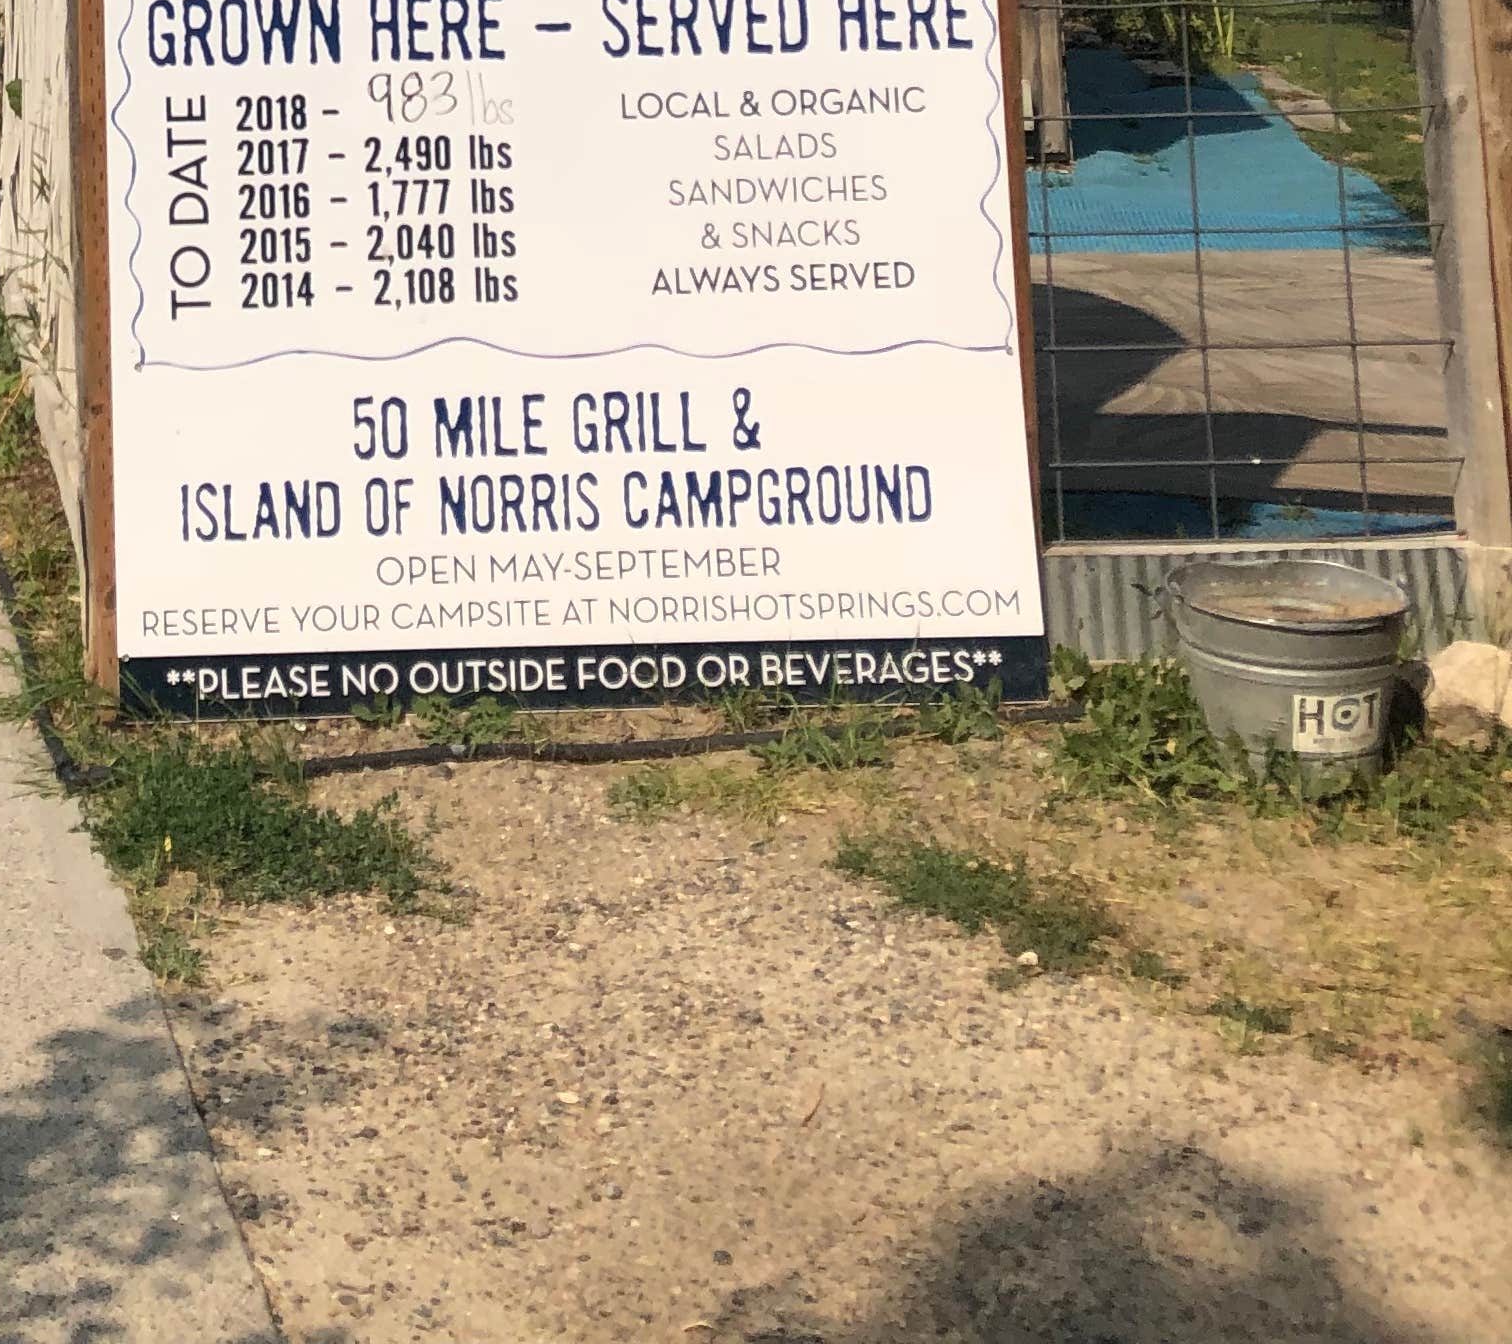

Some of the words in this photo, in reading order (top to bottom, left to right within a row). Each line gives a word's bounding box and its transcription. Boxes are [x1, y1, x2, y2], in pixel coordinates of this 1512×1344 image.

[235, 94, 307, 132] 2018
[367, 71, 458, 123] 983
[621, 91, 730, 120] LOCAL
[739, 90, 762, 117] &
[771, 86, 926, 116] ORGANIC
[165, 94, 209, 225] DATE
[237, 137, 309, 176] 2017
[364, 135, 451, 177] 2,490
[469, 134, 513, 170] lbs
[714, 132, 837, 161] SALADS
[238, 182, 310, 220] 2016
[367, 178, 451, 222] 1,777
[471, 178, 514, 214] lbs
[668, 174, 887, 207] SANDWICHES
[239, 226, 311, 265] 2015
[366, 223, 455, 266] 2,040
[472, 222, 516, 259] lbs
[701, 222, 721, 250] &
[732, 219, 861, 249] SNACKS
[169, 245, 212, 321] TO
[241, 271, 315, 309] 2014
[373, 266, 455, 310] 2,108
[474, 266, 519, 303] lbs
[651, 264, 780, 296] ALWAYS
[790, 261, 915, 291] SERVED
[353, 395, 409, 460] 50
[433, 393, 548, 458] MILE
[573, 390, 707, 454] GRILL
[732, 387, 761, 451] &
[181, 479, 341, 541] ISLAND
[365, 477, 414, 537] OF
[439, 472, 600, 535] NORRIS
[623, 463, 932, 529] CAMPGROUND
[376, 554, 476, 586] OPEN
[489, 546, 781, 583] MAY-SEPTEMBER
[142, 606, 281, 637] RESERVE
[291, 604, 380, 632] YOUR
[391, 599, 551, 630] CAMPSITE
[562, 598, 598, 625] AT
[609, 589, 1020, 624] NORRISHOTSPRINGS.COM
[341, 662, 399, 696] NO
[409, 657, 567, 694] OUTSIDE
[577, 655, 687, 690] FOOD
[696, 653, 750, 688] OR
[1299, 693, 1378, 735] HOT
